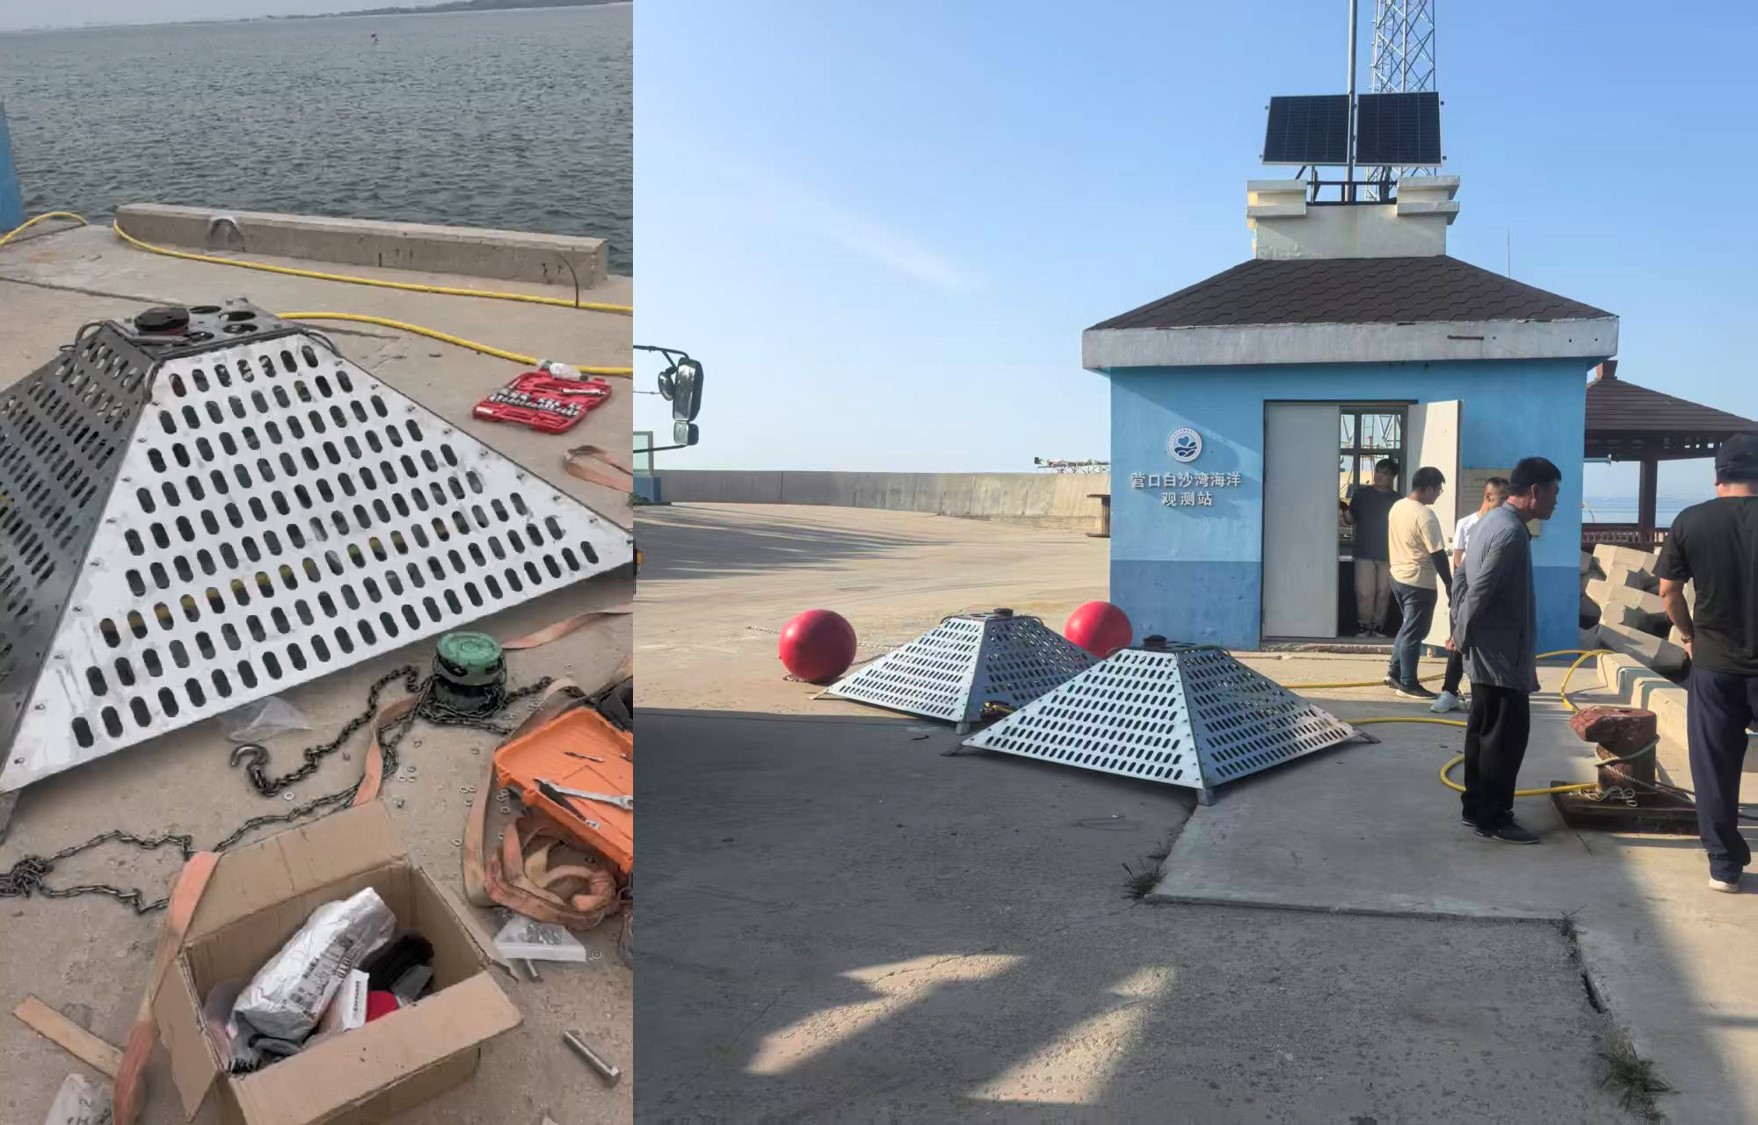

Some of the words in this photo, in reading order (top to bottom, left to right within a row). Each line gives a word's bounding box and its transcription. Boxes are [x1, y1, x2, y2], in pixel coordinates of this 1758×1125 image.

[1131, 472, 1242, 488] 营口白沙湾海洋
[1161, 491, 1213, 507] 观测站
